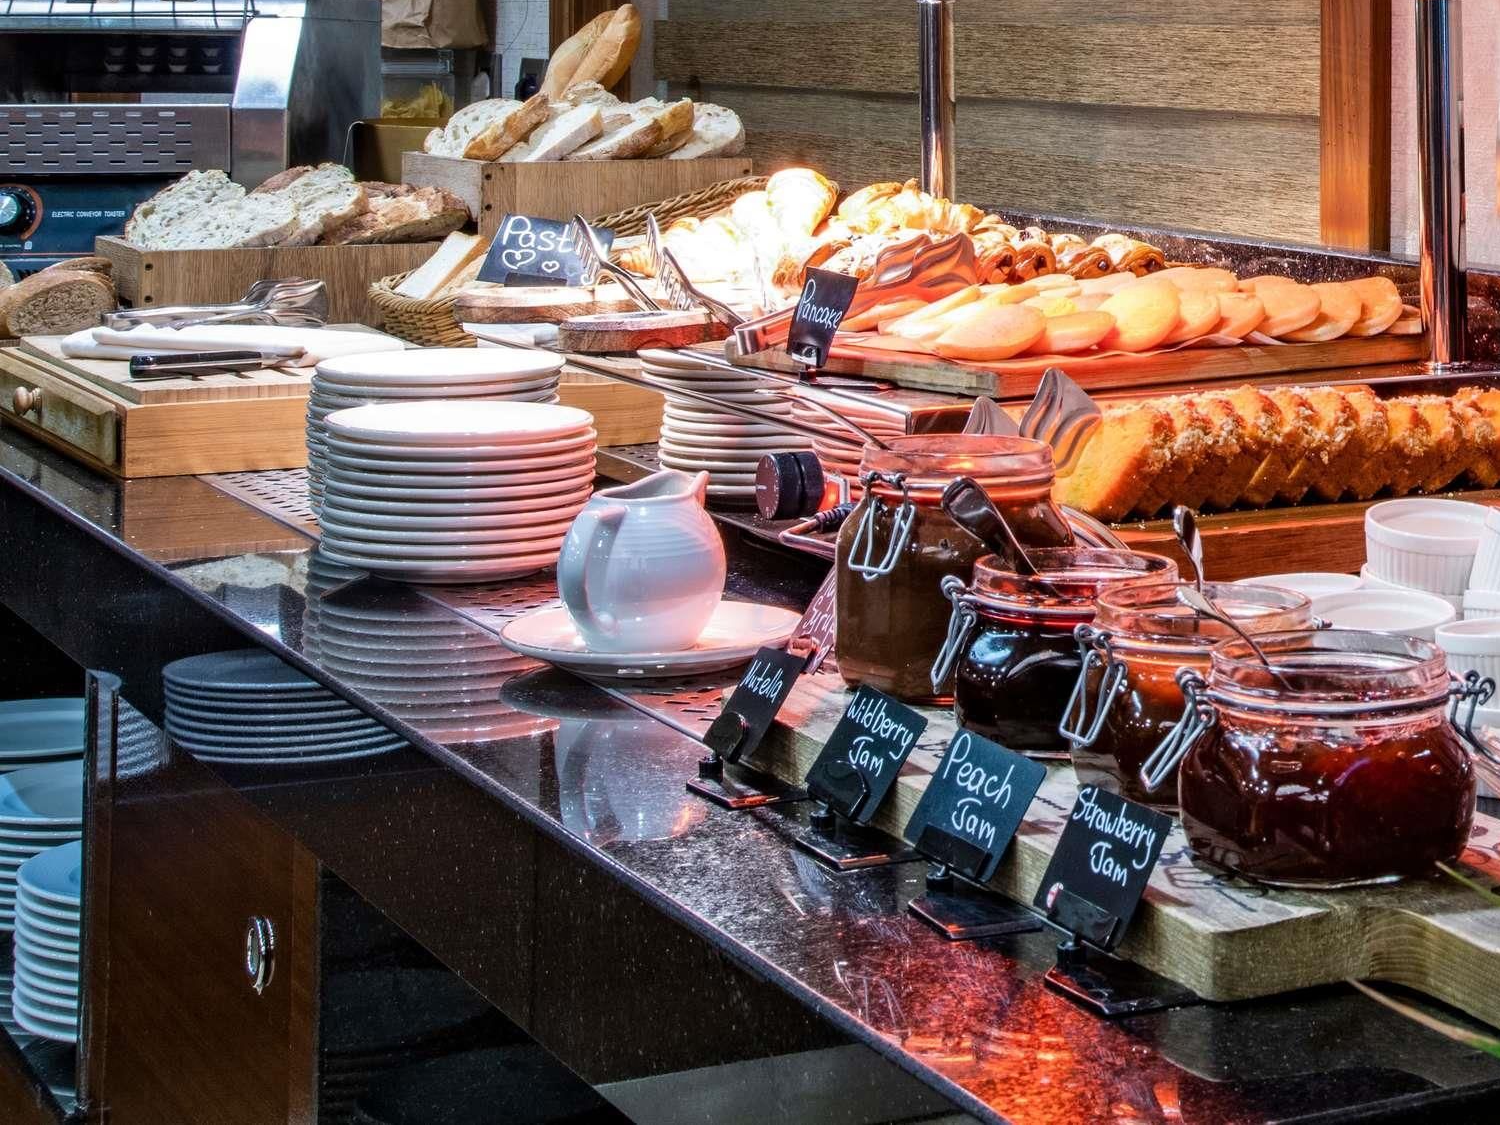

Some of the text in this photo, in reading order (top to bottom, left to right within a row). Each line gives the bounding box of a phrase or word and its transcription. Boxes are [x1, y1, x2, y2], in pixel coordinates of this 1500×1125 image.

[502, 215, 602, 257] Past
[795, 278, 843, 330] Pancake
[739, 660, 783, 704] Nutella
[846, 691, 914, 761] Wildberry
[848, 737, 883, 778] Jam
[943, 733, 1015, 808] Peach
[950, 797, 996, 848] Jam
[1071, 786, 1157, 868] Strawberry
[1090, 842, 1128, 887] Jam
